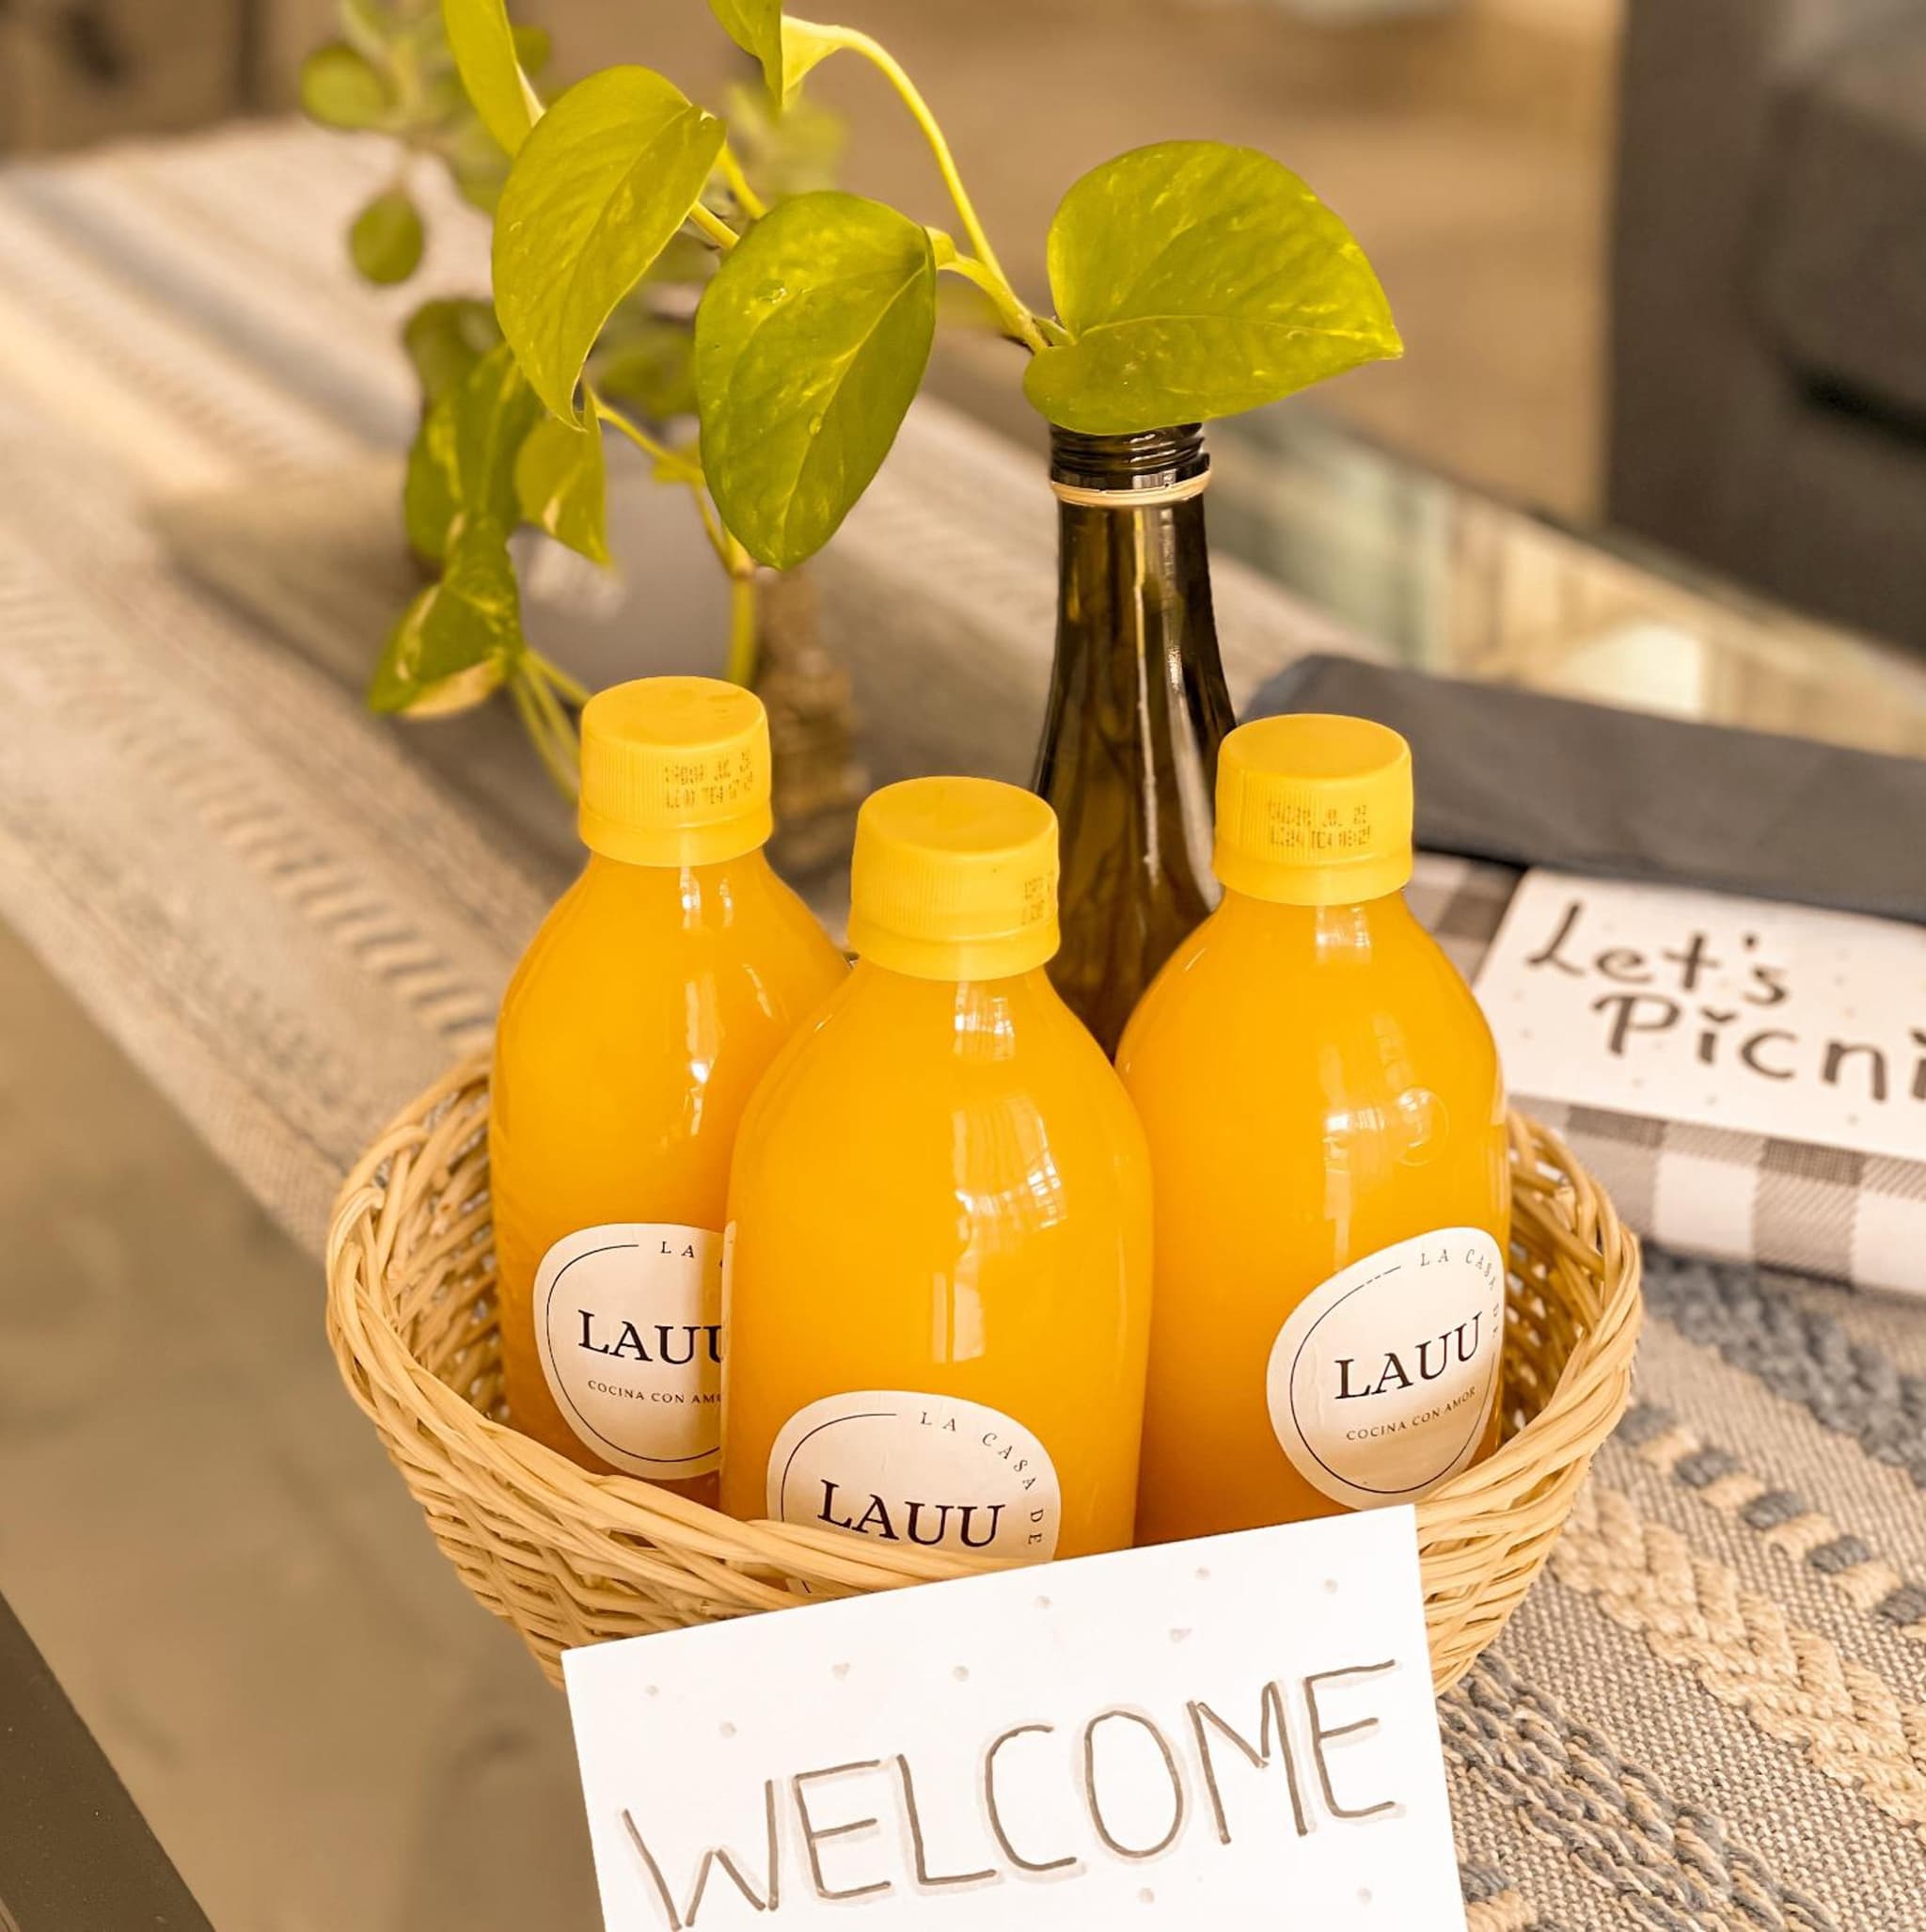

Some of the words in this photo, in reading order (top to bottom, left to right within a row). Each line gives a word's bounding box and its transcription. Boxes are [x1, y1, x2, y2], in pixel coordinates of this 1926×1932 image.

[1525, 900, 1790, 1006] Let's
[661, 1241, 696, 1259] LA
[1420, 1248, 1449, 1267] LA
[1334, 1311, 1483, 1400] LAUU
[587, 1379, 645, 1401] COCINA
[651, 1392, 685, 1403] CON
[1346, 1421, 1408, 1441] COCINA
[1412, 1407, 1441, 1426] CON
[1444, 1386, 1476, 1412] AMOR
[920, 1411, 957, 1433] LA
[982, 1432, 1037, 1491] CASA
[1028, 1509, 1045, 1545] DE
[816, 1479, 1006, 1548] LAUU
[621, 1658, 1399, 1932] WELCOME
